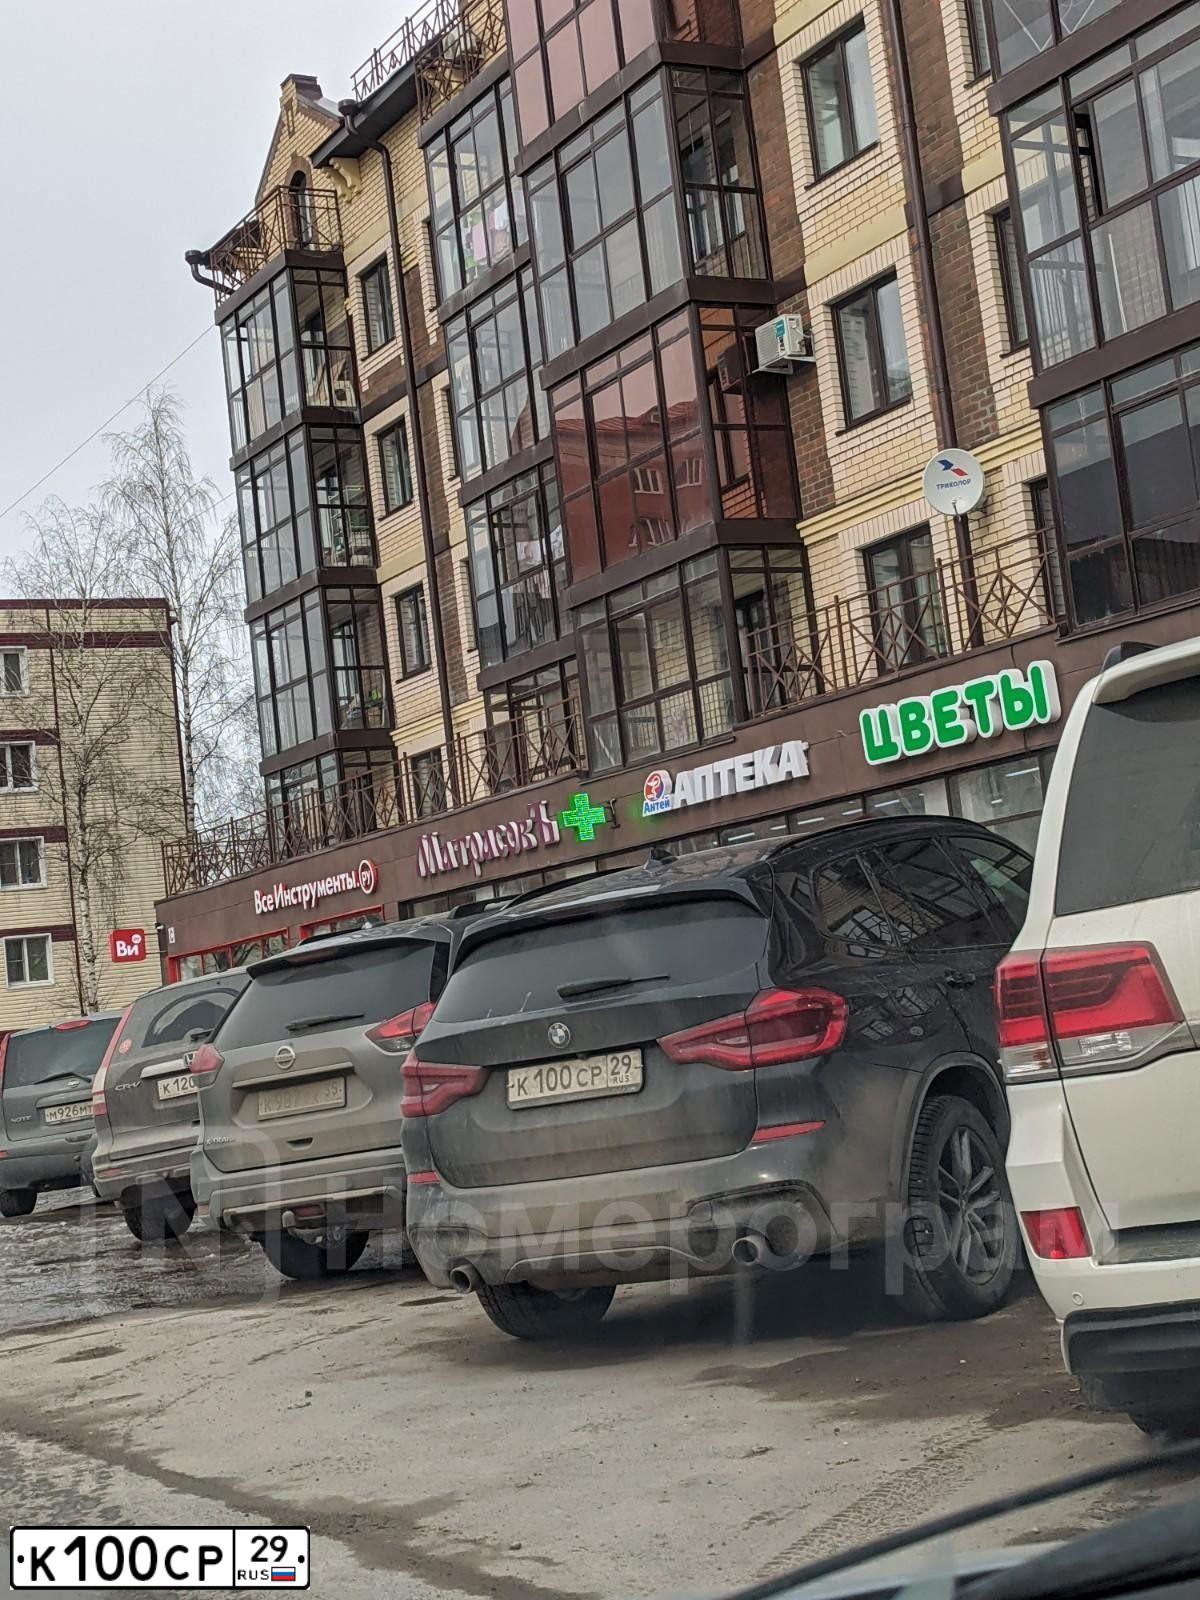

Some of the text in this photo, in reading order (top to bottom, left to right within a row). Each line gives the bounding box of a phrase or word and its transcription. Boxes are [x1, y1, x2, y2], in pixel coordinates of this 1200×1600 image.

[936, 479, 971, 490] ТРИКОЛОР
[860, 659, 1061, 766] ЦВЕТЫ
[673, 740, 809, 809] АПТЕКА
[643, 796, 671, 814] Антей
[610, 1054, 632, 1077] 29
[612, 1074, 630, 1084] RUS
